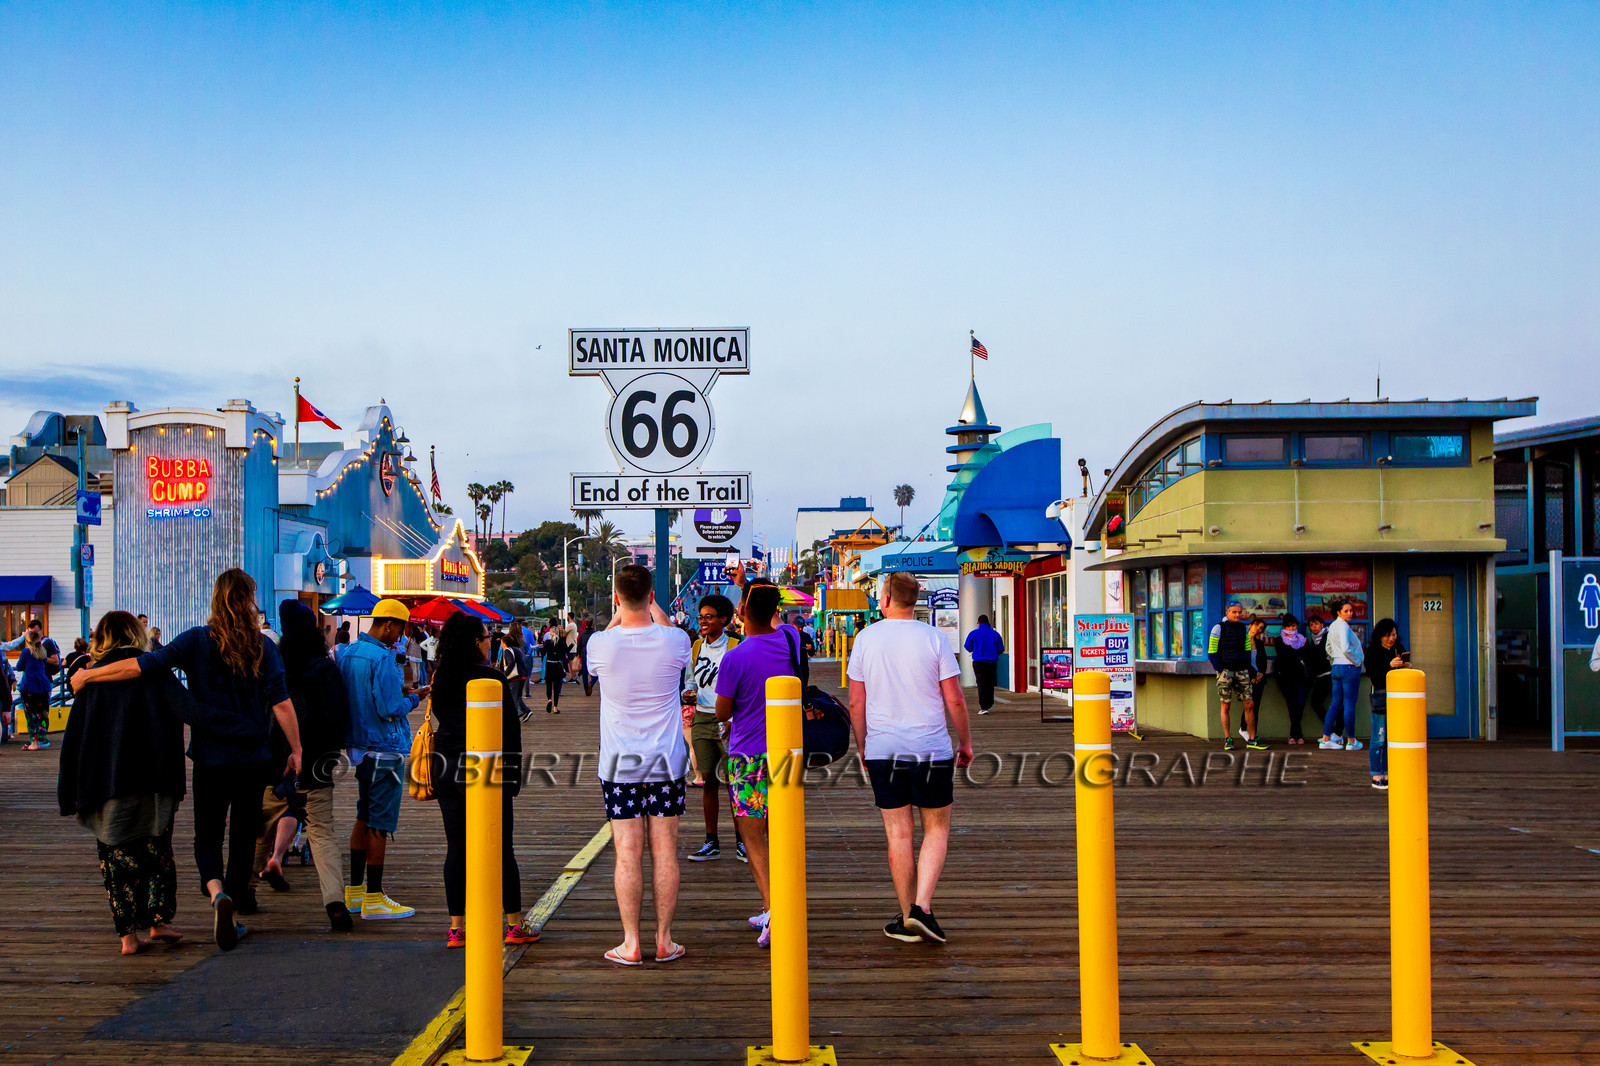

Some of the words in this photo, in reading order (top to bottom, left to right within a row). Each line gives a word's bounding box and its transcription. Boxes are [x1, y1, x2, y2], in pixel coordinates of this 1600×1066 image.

[576, 337, 646, 363] SANTA
[654, 336, 743, 363] MONICA
[621, 390, 699, 459] 66
[147, 456, 211, 478] BUBBA
[152, 480, 207, 502] GUMP
[580, 479, 619, 502] End
[627, 478, 650, 501] of
[656, 478, 690, 501] the
[696, 478, 742, 501] Trail
[147, 508, 190, 518] SHRIMP
[193, 508, 210, 517] CO
[442, 558, 458, 575] BUBBA
[901, 556, 934, 567] POLICE
[963, 561, 993, 575] BLAZING
[994, 561, 1024, 574] SADDLES
[1423, 600, 1442, 611] 322
[1108, 638, 1127, 648] BUY
[1106, 655, 1126, 664] HERE
